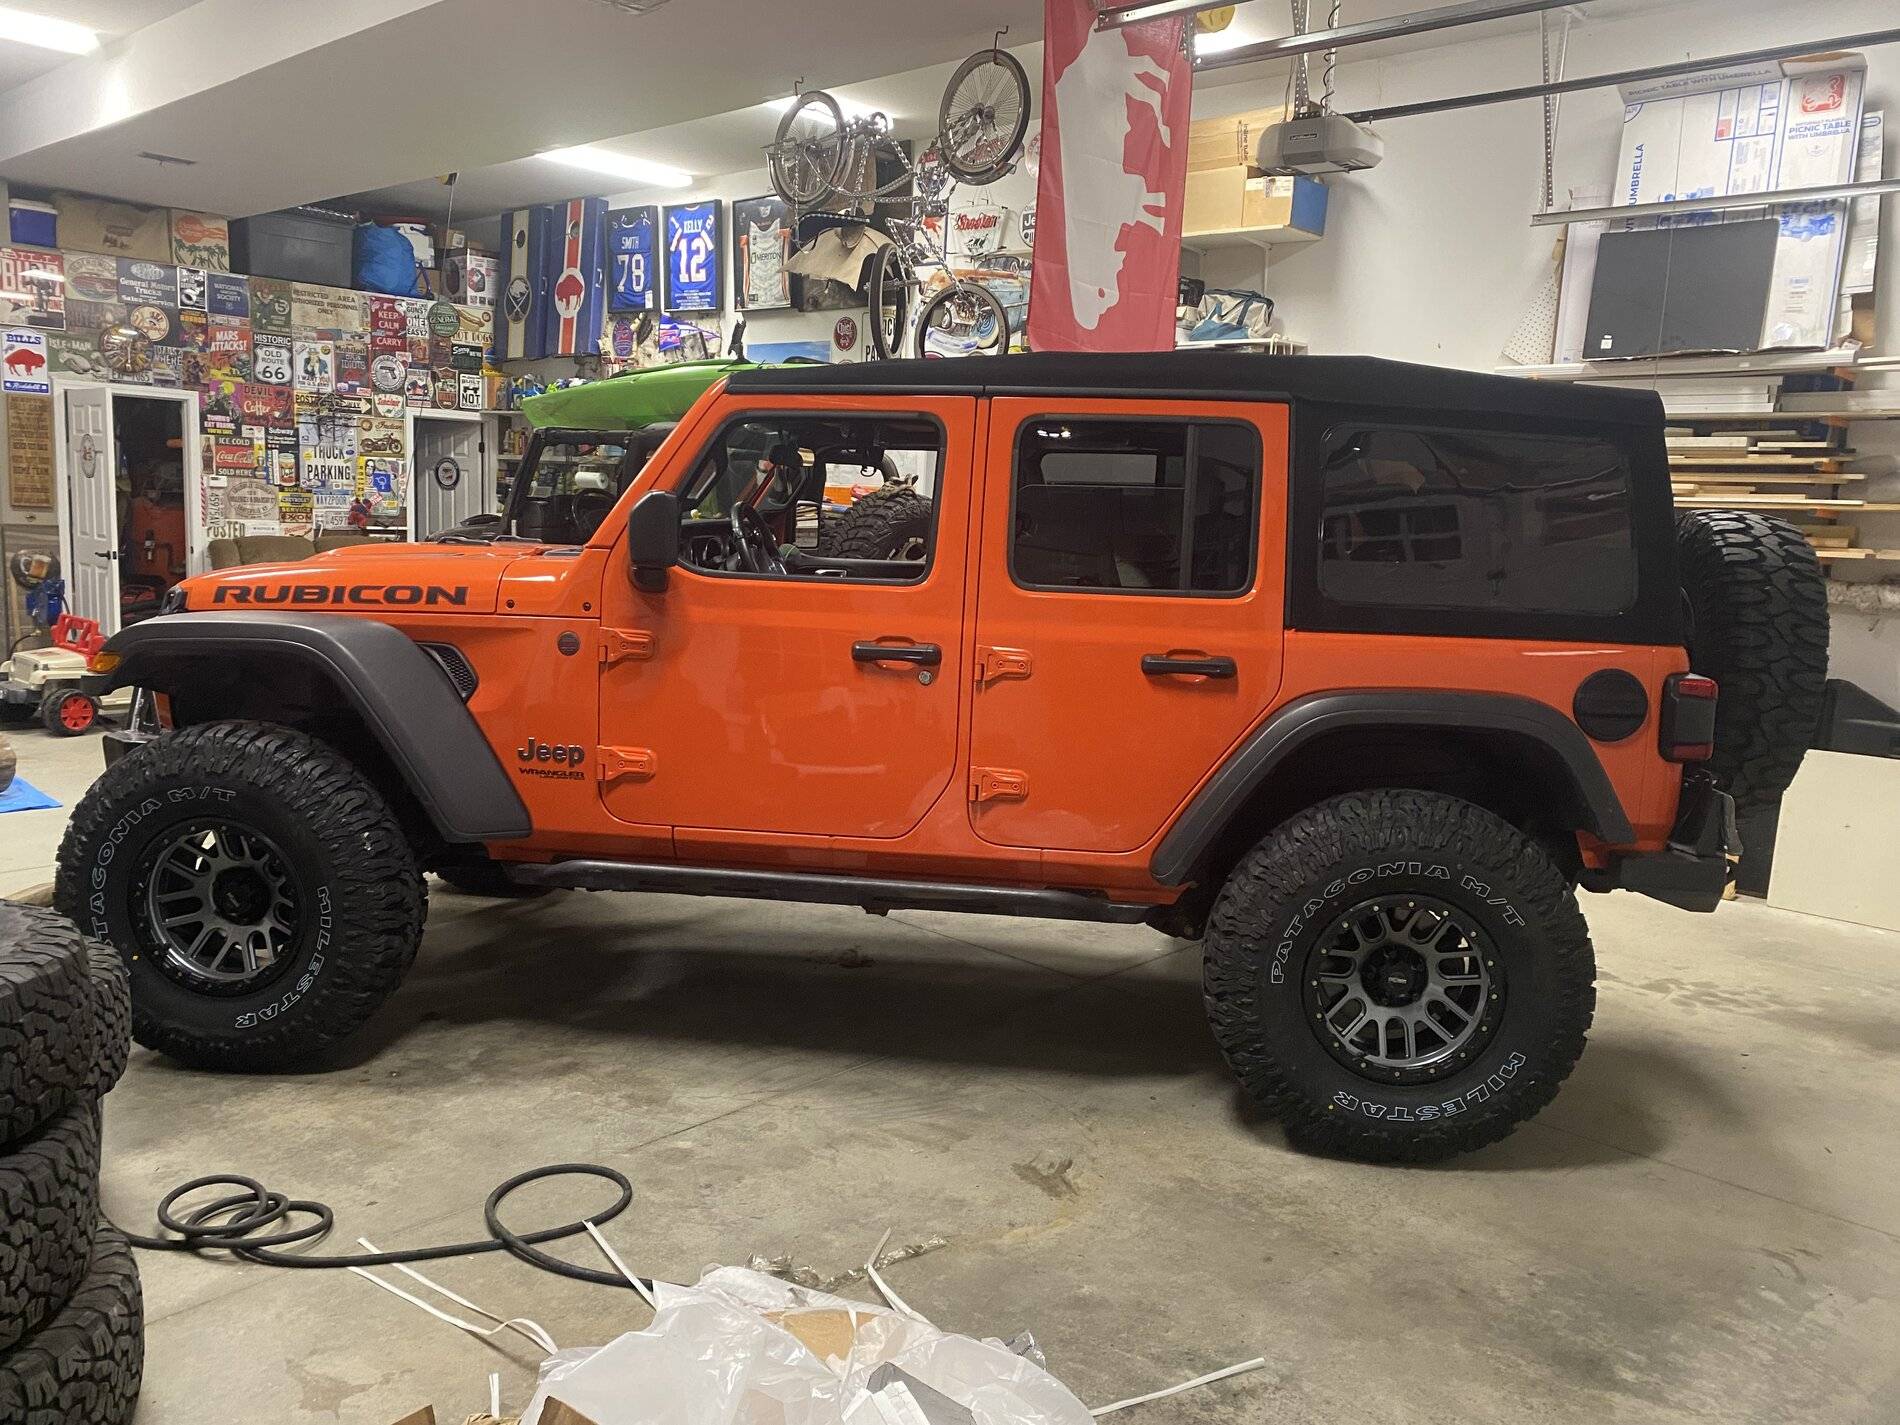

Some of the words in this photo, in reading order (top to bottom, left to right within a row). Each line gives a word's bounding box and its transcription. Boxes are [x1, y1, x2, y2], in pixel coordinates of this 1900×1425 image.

[1789, 124, 1820, 134] PICNIC
[1822, 120, 1852, 130] TABLE
[1810, 128, 1851, 138] UMBRELLA
[1628, 143, 1645, 206] UMBRELLA
[683, 219, 703, 234] KELLY
[1024, 215, 1036, 227] Je
[621, 236, 640, 249] SMITH
[679, 237, 707, 283] 12
[617, 253, 645, 293] 78
[120, 277, 149, 288] General
[134, 287, 162, 296] Trucks
[337, 295, 356, 303] AREA
[378, 310, 399, 319] KEEP
[378, 321, 400, 330] CALM
[6, 333, 42, 345] BILLS
[215, 330, 238, 341] MARS
[253, 333, 292, 345] HISTORIC
[48, 337, 66, 348] ISLE
[210, 340, 248, 352] ATTACKS!
[376, 337, 403, 347] CARRY
[264, 349, 282, 358] OLD
[262, 357, 285, 365] ROUTE
[262, 365, 285, 380] 66
[244, 385, 273, 397] DEVIL
[461, 393, 480, 404] NOT
[268, 427, 294, 436] Subway
[232, 438, 250, 446] COLD
[313, 445, 345, 460] TRUCK
[218, 468, 235, 476] SOLD
[307, 464, 351, 480] PARKING
[212, 585, 470, 606] RUBICON
[517, 736, 585, 768] Jeep
[518, 767, 585, 778] WRANGLER
[90, 798, 162, 946] TAGONIA
[167, 786, 237, 802] M/T
[1271, 861, 1451, 984] PATAGONIA
[1461, 875, 1526, 927] M/T
[234, 886, 332, 1029] MILESTAR
[1332, 1052, 1527, 1122] MILESTAR
